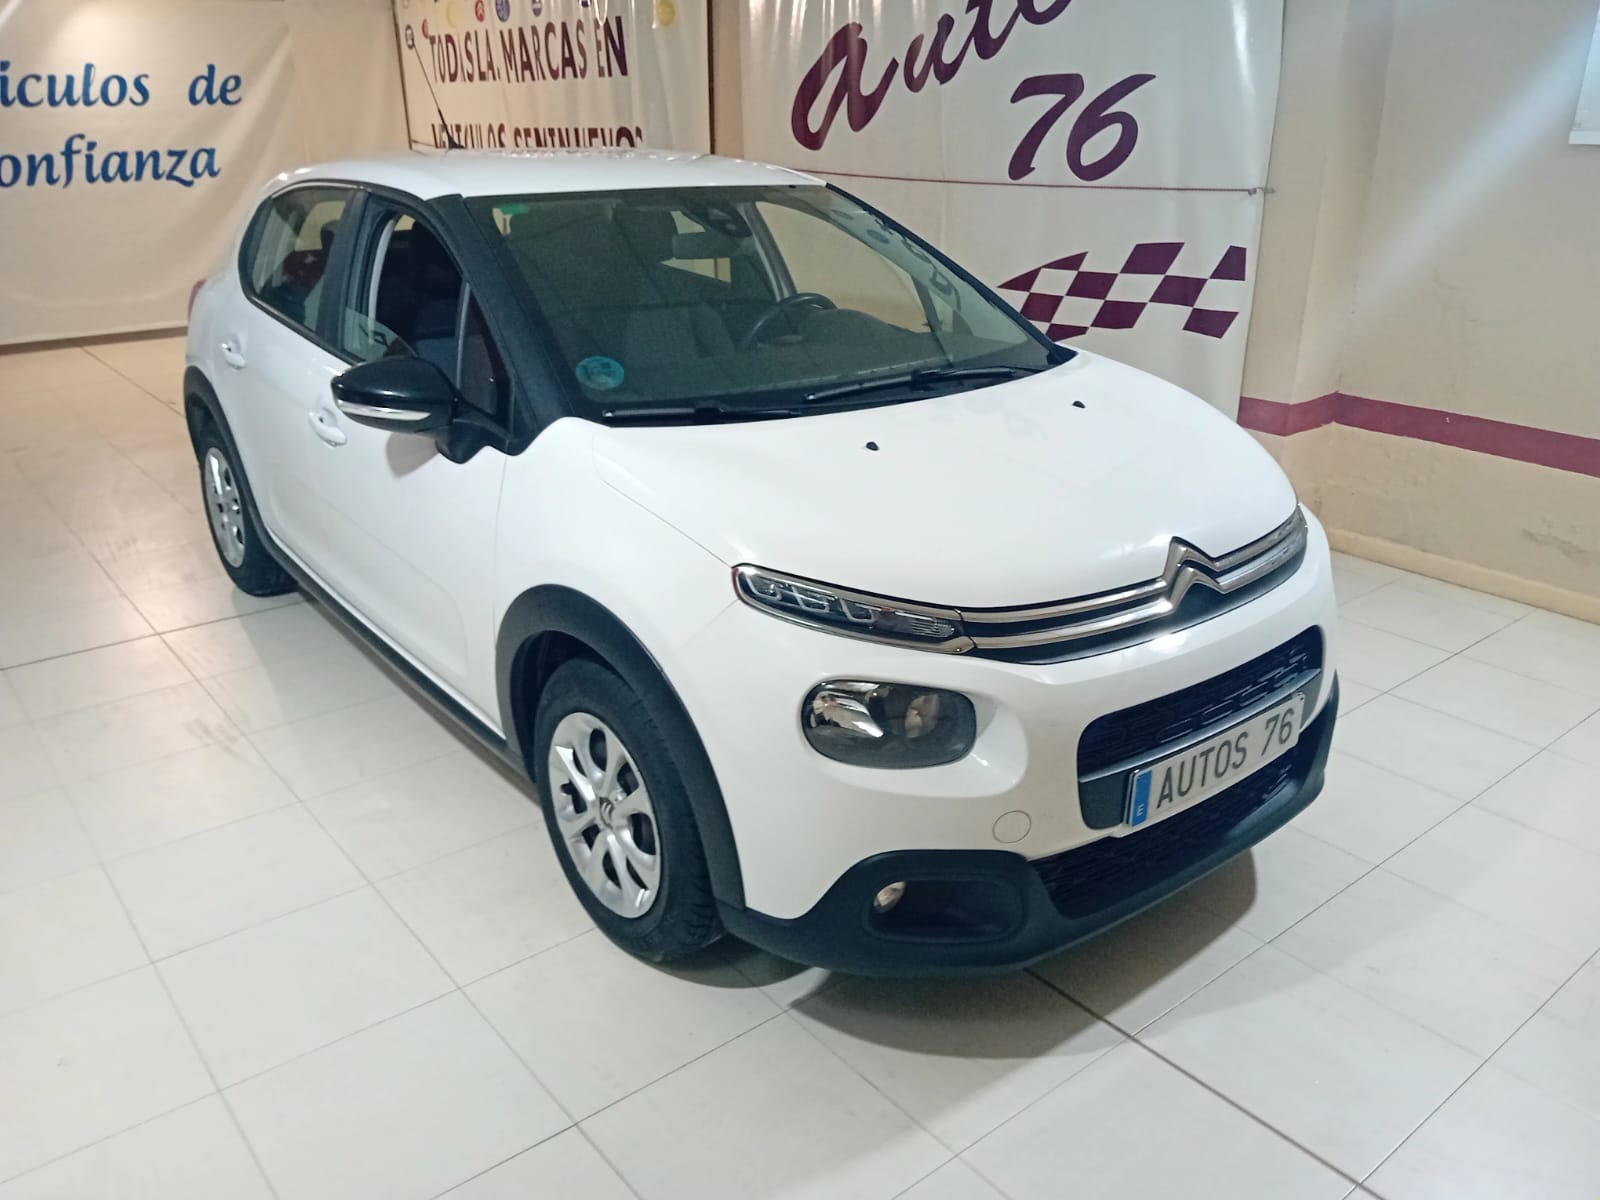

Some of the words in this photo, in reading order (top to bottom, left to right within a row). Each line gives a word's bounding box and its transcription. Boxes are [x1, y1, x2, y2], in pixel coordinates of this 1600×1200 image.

[188, 64, 242, 106] de
[474, 29, 501, 81] LA
[499, 18, 588, 83] MARCAS
[594, 16, 628, 78] EN
[1008, 73, 1157, 182] 76
[1156, 731, 1249, 810] AUTOS
[1261, 707, 1295, 757] 76
